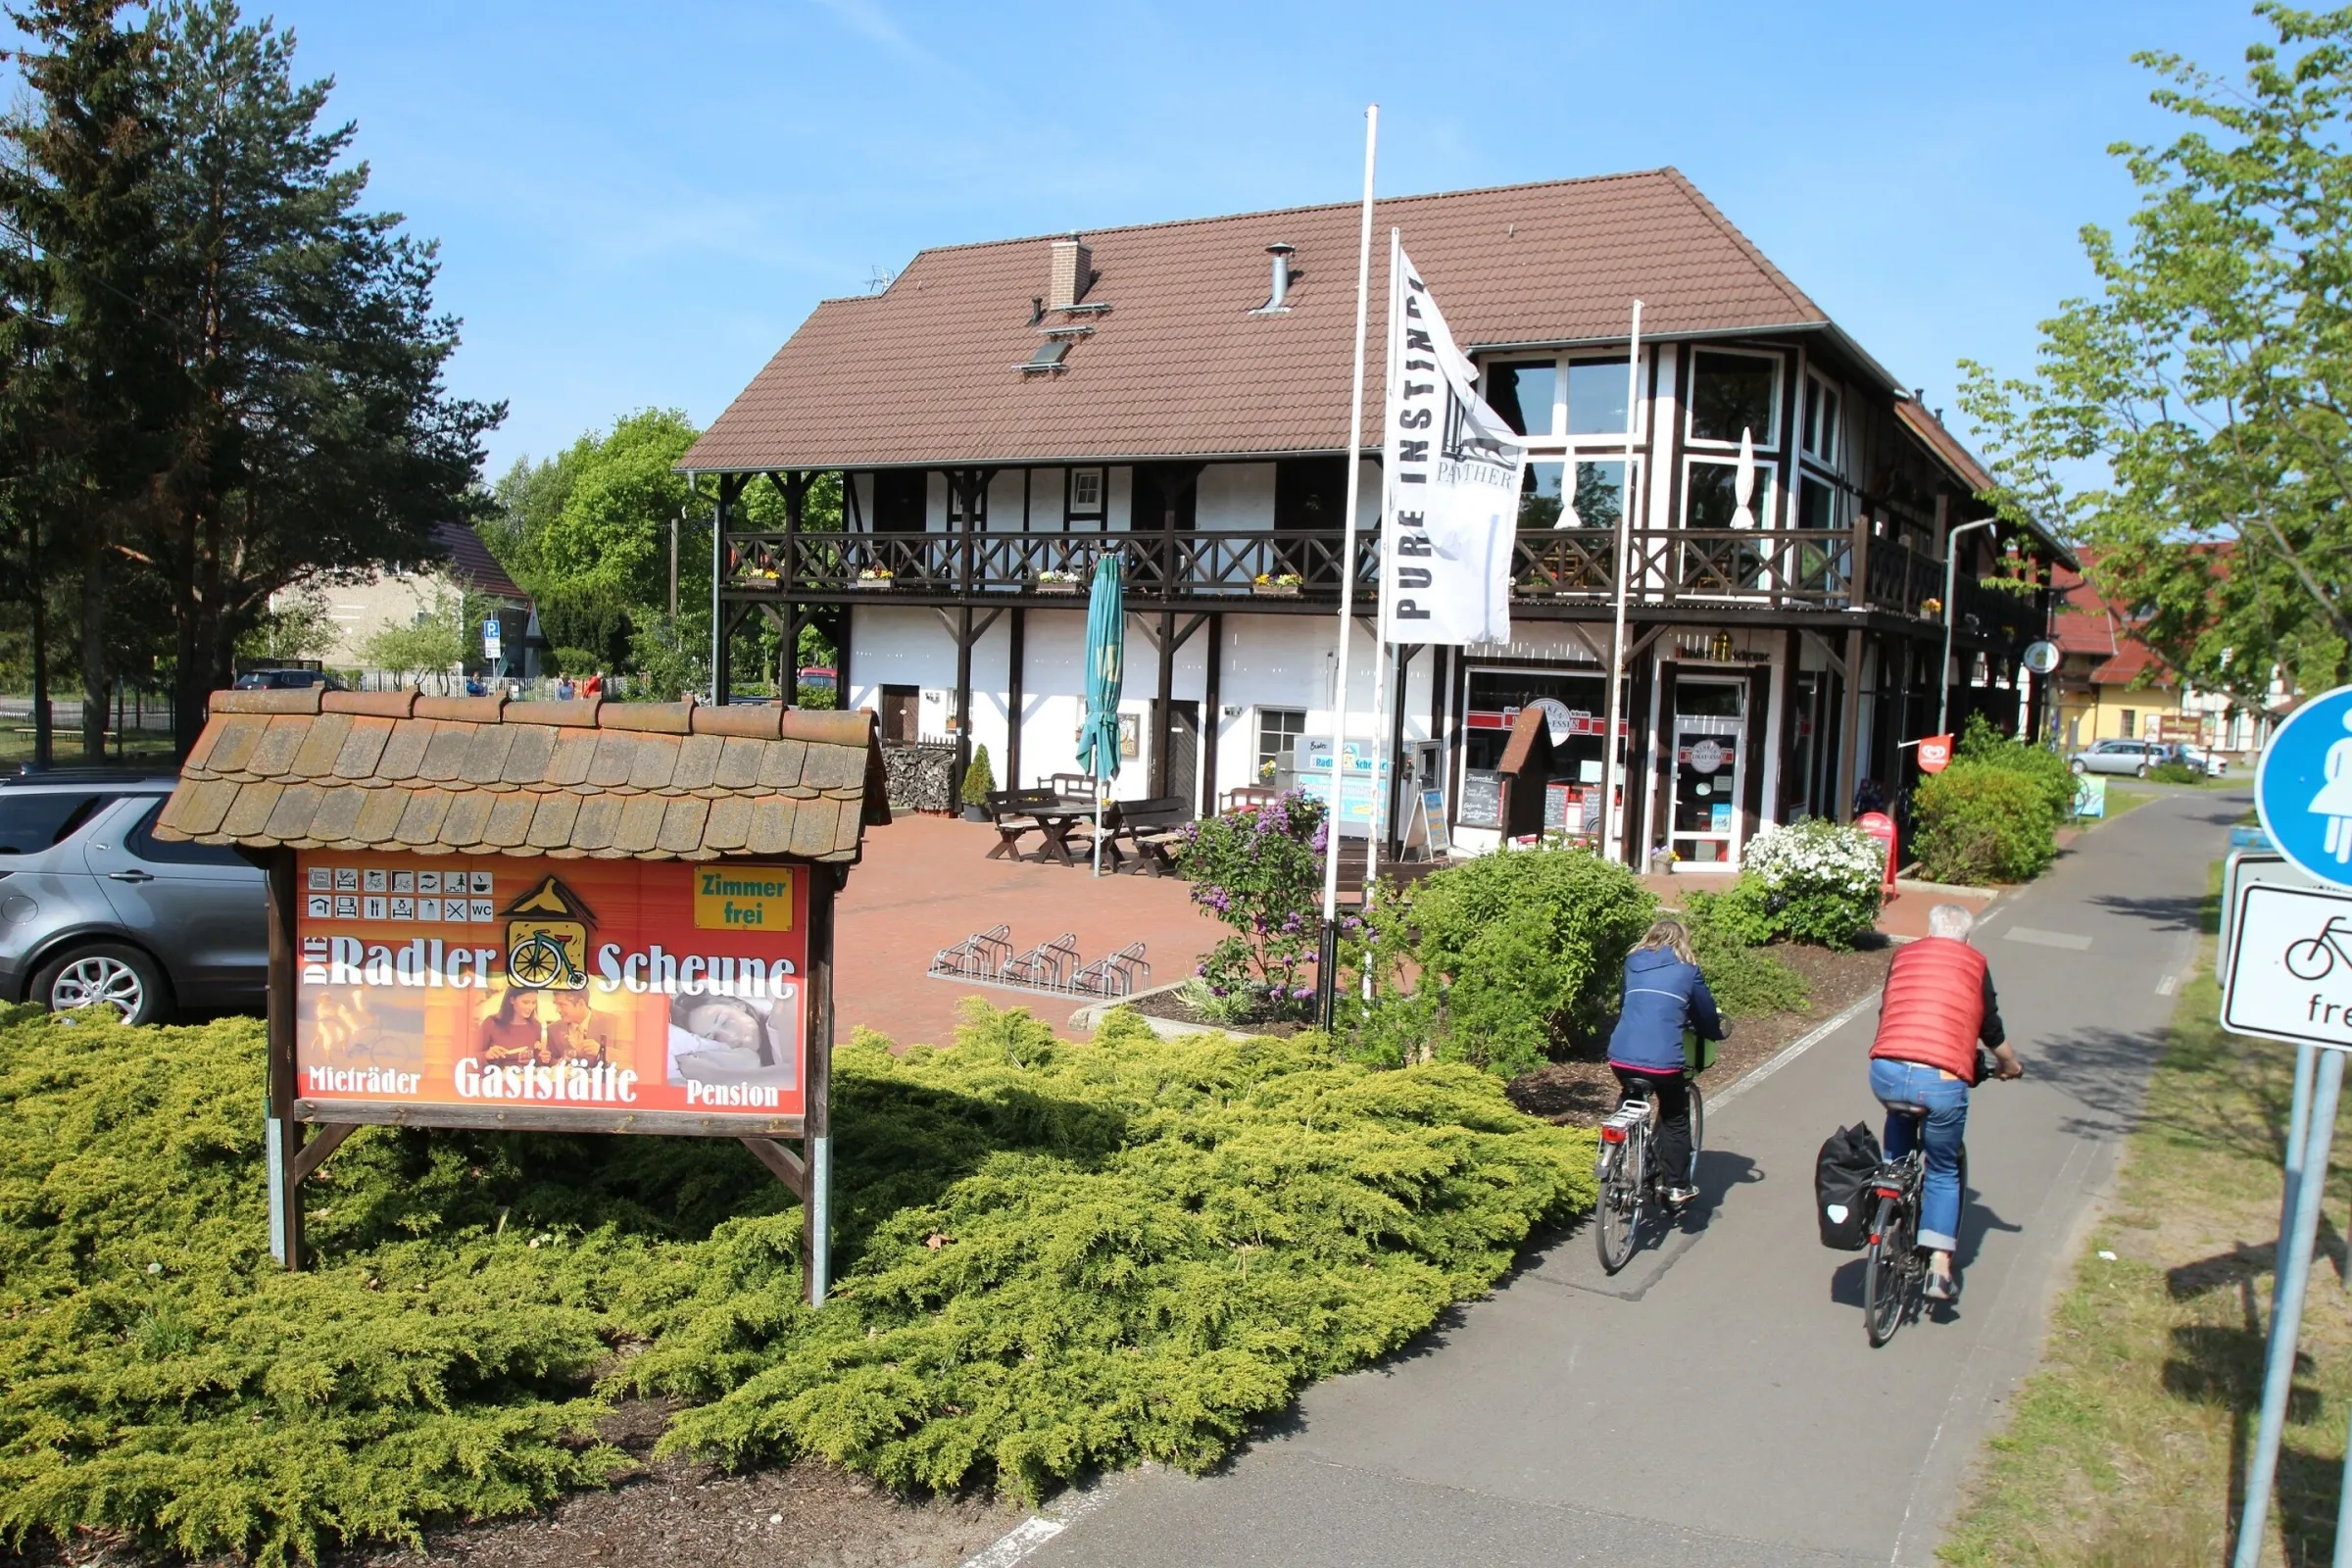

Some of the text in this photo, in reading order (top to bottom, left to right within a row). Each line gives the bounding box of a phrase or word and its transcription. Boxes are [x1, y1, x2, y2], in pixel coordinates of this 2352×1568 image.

[1437, 462, 1512, 490] PANTHER
[1396, 511, 1433, 619] PURE
[487, 622, 496, 637] P
[1316, 758, 1333, 767] Radl
[702, 873, 787, 898] Zimmer
[472, 906, 492, 915] WC
[724, 902, 763, 924] frei
[304, 936, 796, 1000] DIE Radler Scheune
[309, 1065, 421, 1096] Mieträder
[455, 1057, 639, 1103] Gaststätte
[687, 1080, 779, 1107] Pension
